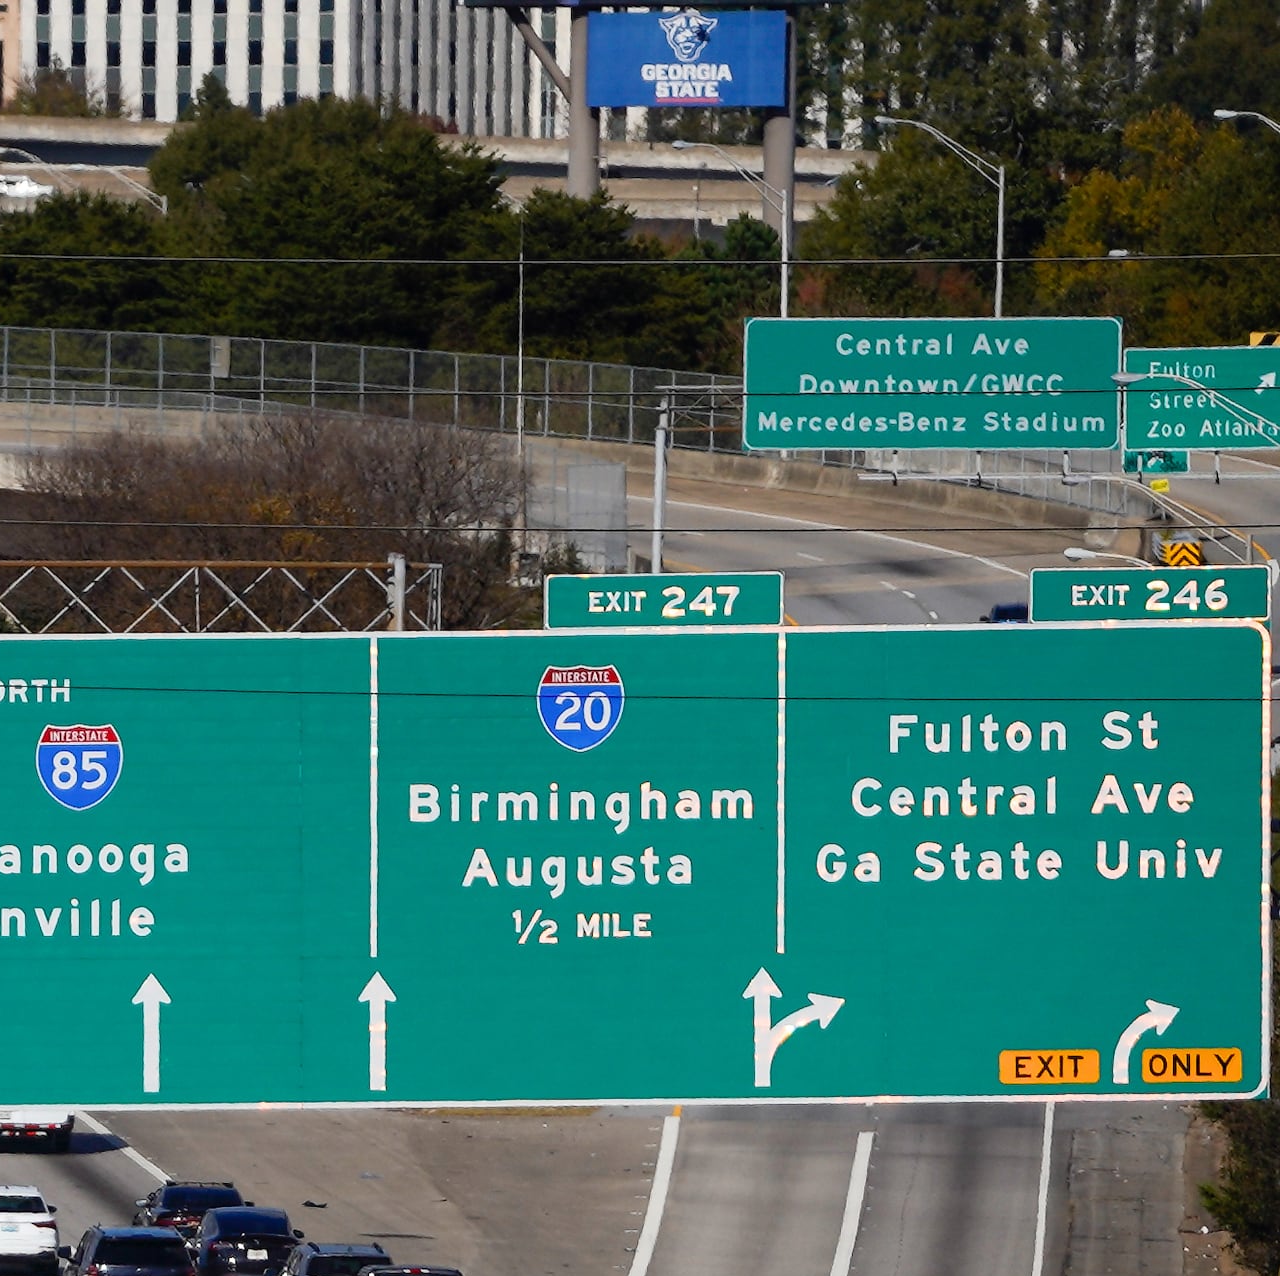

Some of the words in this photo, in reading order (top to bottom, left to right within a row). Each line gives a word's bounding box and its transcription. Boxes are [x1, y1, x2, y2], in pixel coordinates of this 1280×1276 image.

[641, 64, 732, 82] GEORGIA
[655, 81, 719, 98] STATE
[836, 333, 952, 356] Central
[972, 334, 1029, 356] Ave
[1149, 361, 1216, 379] Fulton
[799, 374, 1063, 397] Downtown/GWCC
[1149, 392, 1217, 409] Street
[758, 411, 967, 432] Mercedes-Benz
[984, 411, 1106, 432] Stadium
[1147, 420, 1186, 438] Zoo
[587, 590, 647, 613] EXIT
[661, 586, 740, 618] 247
[1070, 584, 1130, 607] EXIT
[1145, 578, 1229, 612] 246
[551, 671, 610, 683] INTERSTATE
[555, 691, 612, 732] 20
[49, 730, 109, 742] INTERSTATE
[888, 714, 1068, 755] Fulton
[1100, 710, 1160, 751] St
[51, 750, 108, 790] 85
[408, 781, 755, 836] Birmingham
[850, 776, 1058, 818] Central
[1090, 774, 1195, 816] Ave
[461, 845, 694, 900] Augusta
[815, 843, 882, 884] Ga
[912, 841, 1063, 883] State
[1095, 838, 1224, 881] Univ
[575, 912, 653, 940] MILE
[1013, 1054, 1085, 1080] EXIT
[1148, 1052, 1235, 1079] ONLY
